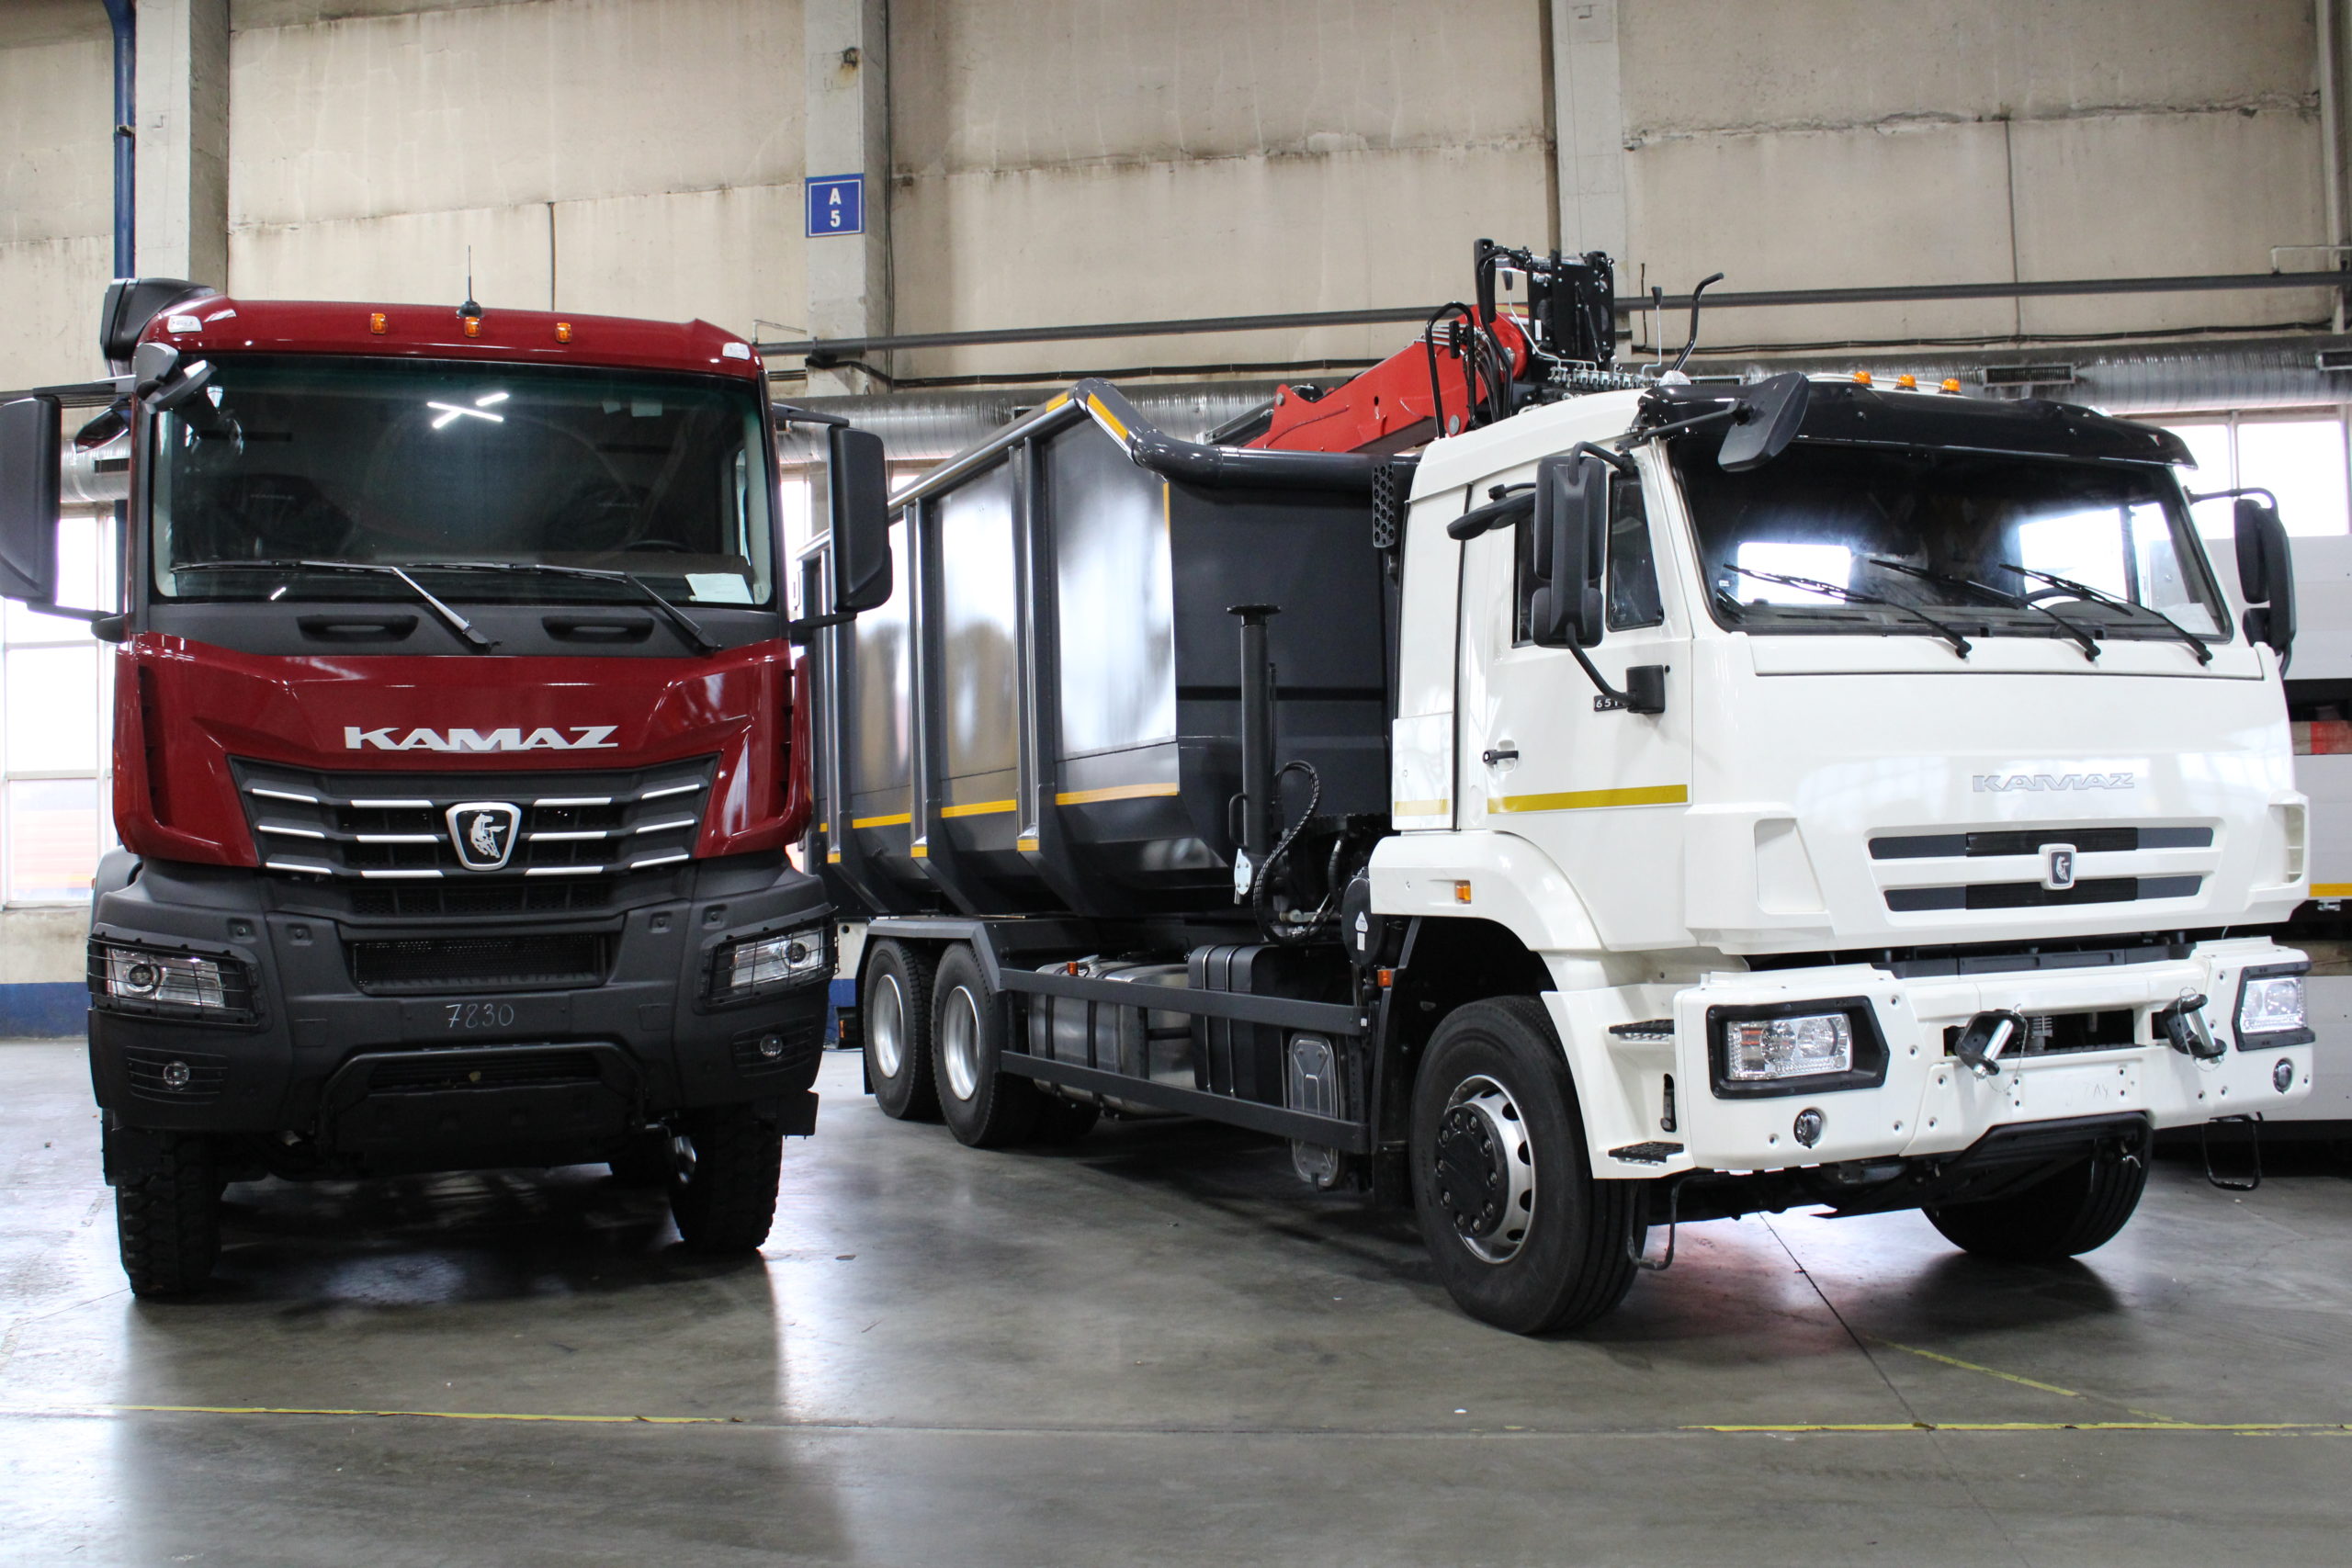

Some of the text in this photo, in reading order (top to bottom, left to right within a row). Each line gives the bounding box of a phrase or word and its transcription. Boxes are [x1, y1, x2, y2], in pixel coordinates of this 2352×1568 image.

[829, 187, 842, 205] A
[830, 209, 841, 228] 5
[344, 725, 619, 751] KAMAZ
[1972, 773, 2135, 793] KAMAZ
[445, 1003, 514, 1029] 7830
